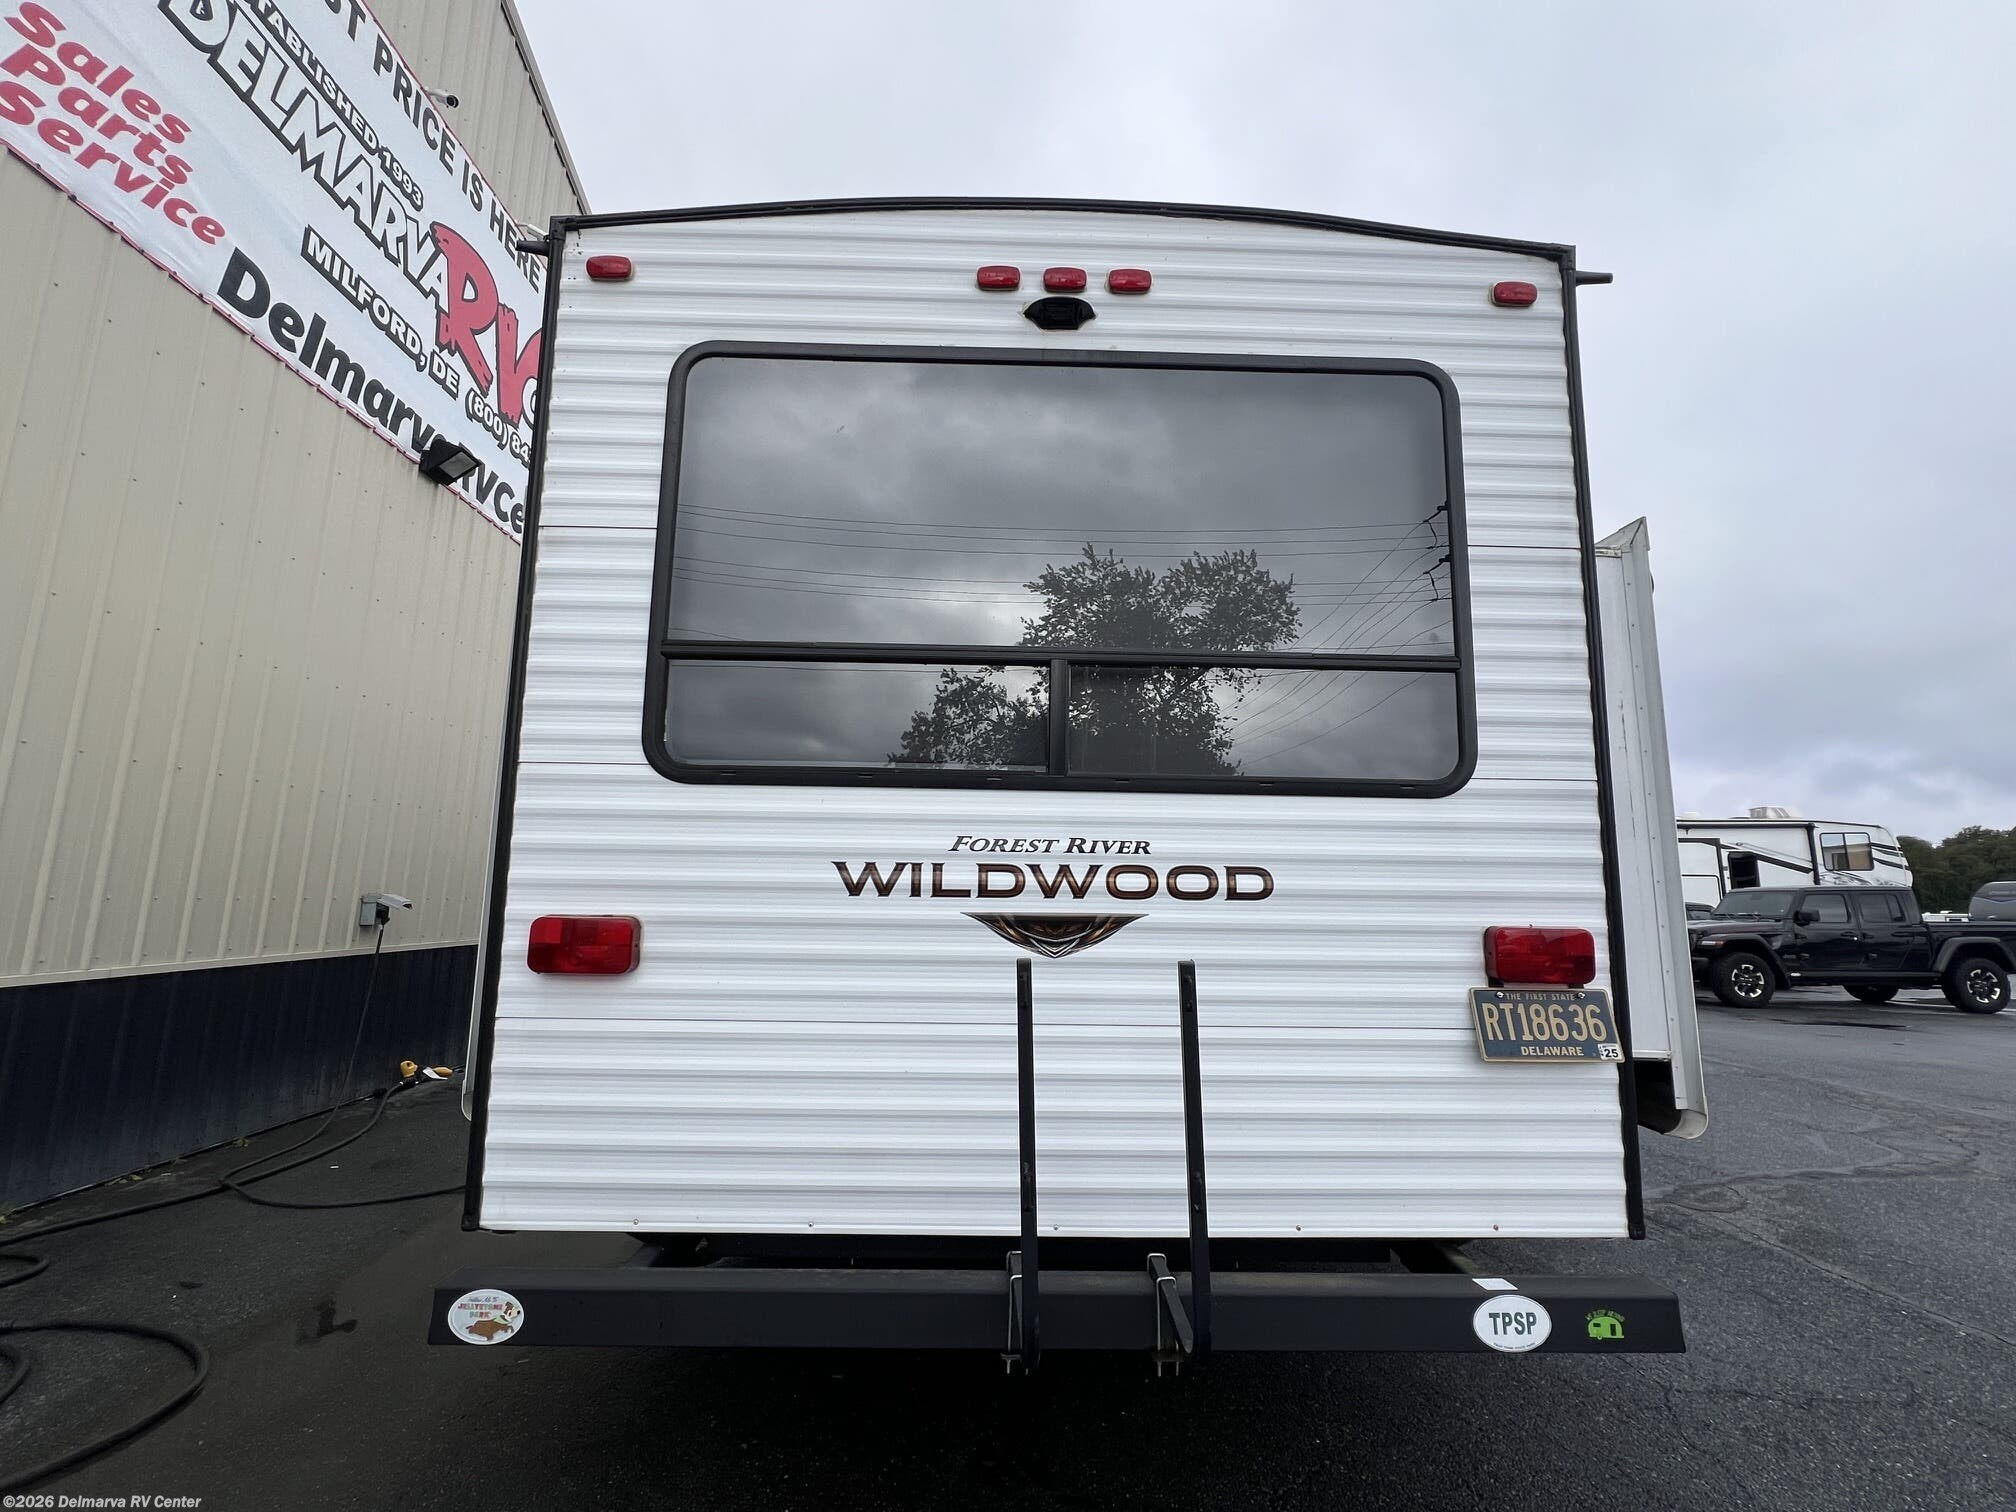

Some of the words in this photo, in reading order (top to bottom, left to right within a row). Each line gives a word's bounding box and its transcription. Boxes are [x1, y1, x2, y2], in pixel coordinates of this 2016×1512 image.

[0, 43, 193, 185] Parts
[4, 2, 192, 144] Sales
[0, 81, 226, 245] Service
[157, 0, 450, 314] DELMARVA
[373, 33, 456, 176] PRICE
[462, 159, 484, 212] IS
[490, 199, 541, 294] HERE
[301, 224, 428, 373] MILFORD,
[429, 347, 460, 401] DE
[465, 387, 509, 450] (800)
[509, 430, 533, 469] 84
[831, 861, 1275, 901] WILDWOOD
[948, 835, 1059, 853] FOREST
[1063, 837, 1151, 854] RIVER
[1481, 1002, 1607, 1042] RT18636
[1525, 993, 1547, 1001] FIRST
[1551, 993, 1576, 1001] STATE
[1520, 1046, 1584, 1056] DELAWARE
[1604, 1048, 1619, 1058] 25
[1488, 1311, 1537, 1335] TPSP
